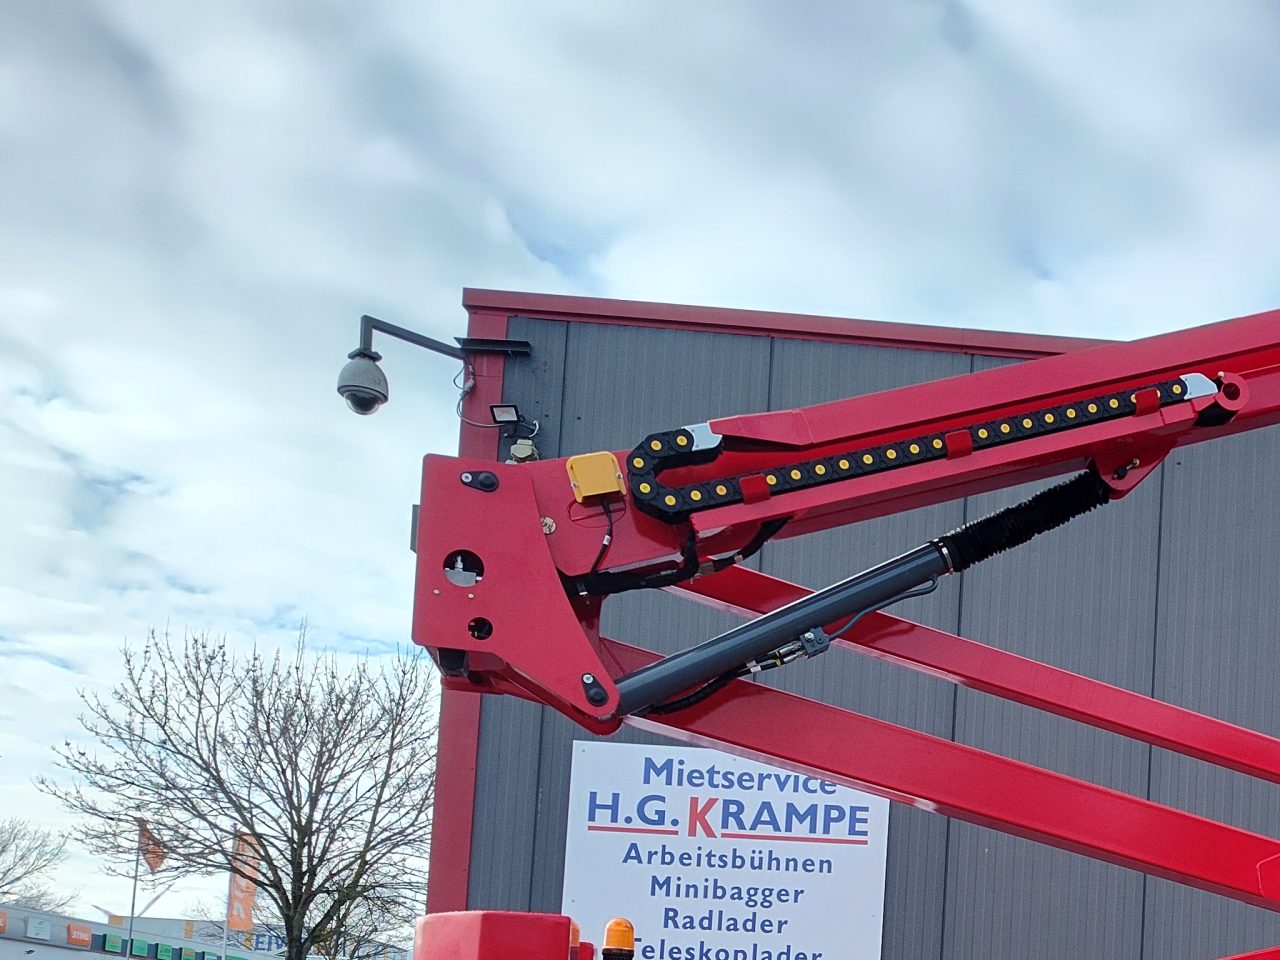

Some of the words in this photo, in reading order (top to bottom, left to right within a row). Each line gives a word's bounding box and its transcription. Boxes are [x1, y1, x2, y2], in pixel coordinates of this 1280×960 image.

[642, 756, 837, 795] Mietservice
[587, 791, 680, 827] H.G.
[687, 796, 870, 839] KRAMPE
[621, 842, 832, 874] Arbeitsbühnen
[650, 875, 805, 909] Minibagger
[663, 906, 789, 934] Radlader
